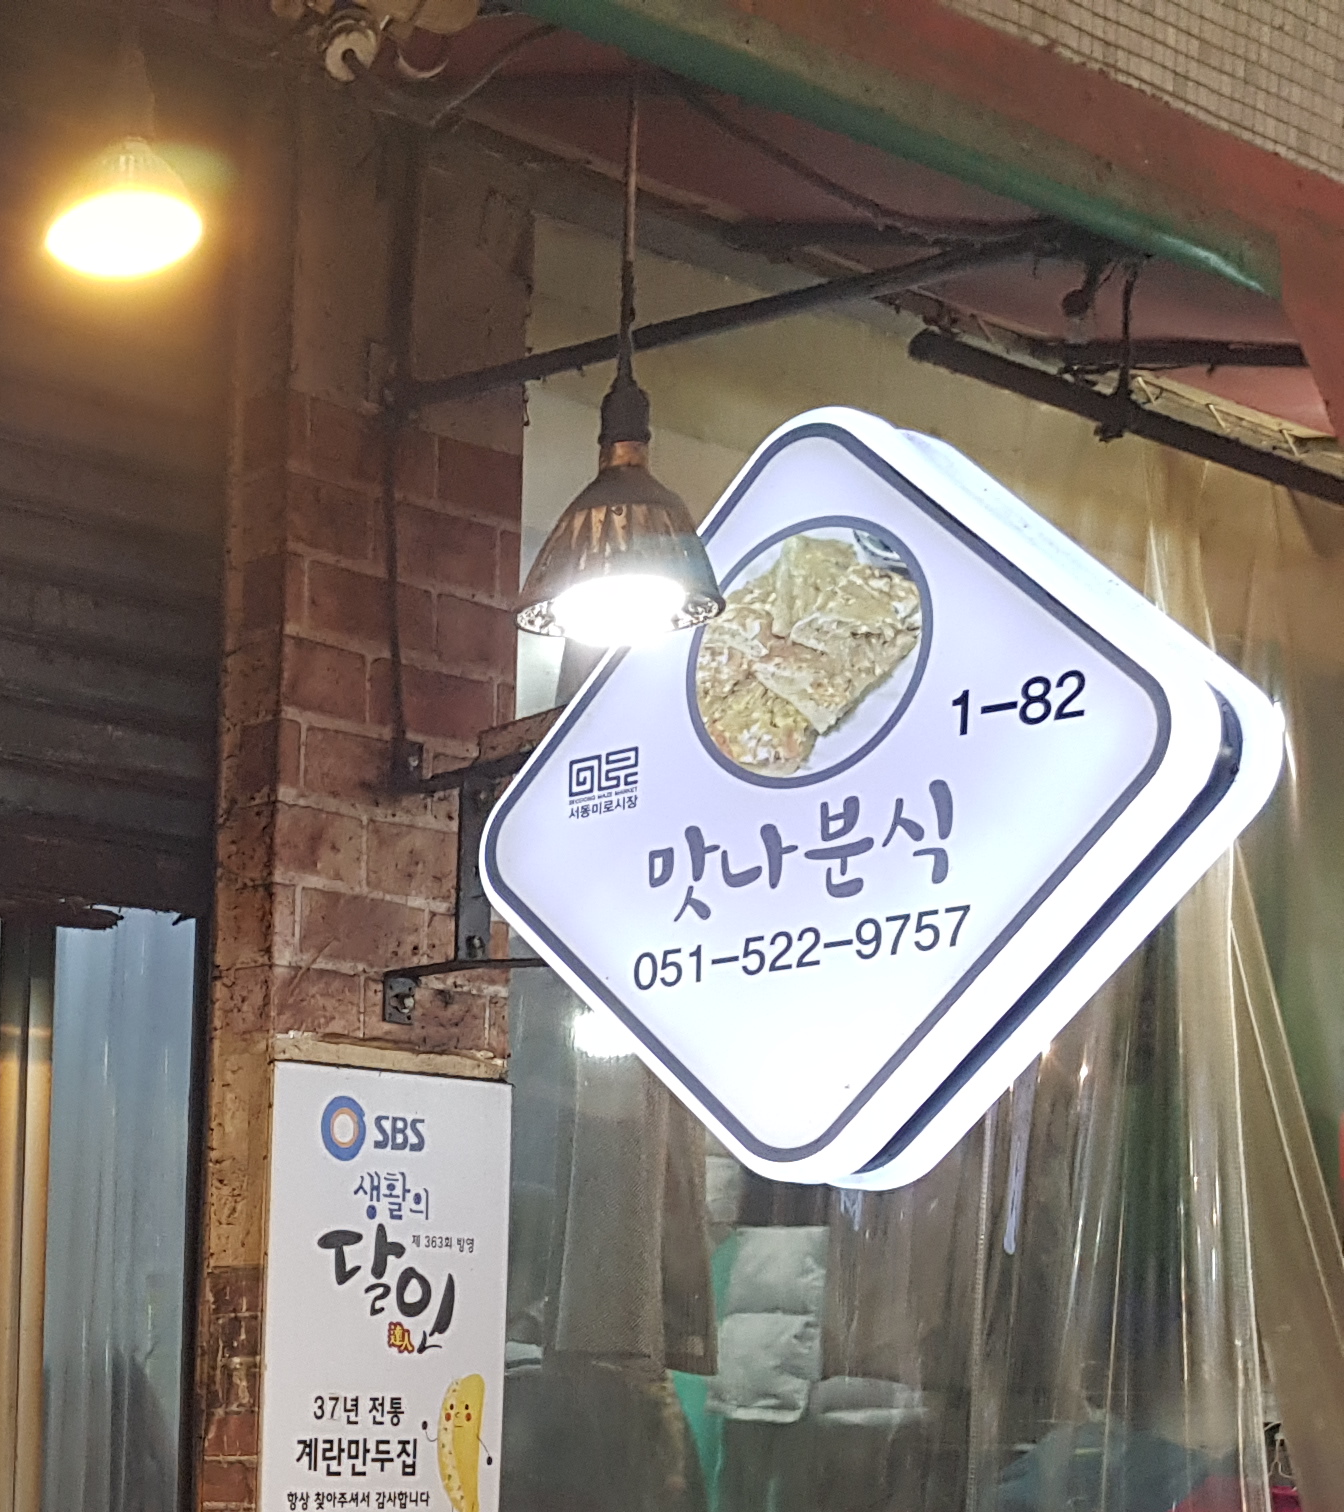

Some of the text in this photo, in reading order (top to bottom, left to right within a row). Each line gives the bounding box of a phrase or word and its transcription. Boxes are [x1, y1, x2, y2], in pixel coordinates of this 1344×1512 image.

[950, 670, 1087, 737] 1-82
[568, 794, 638, 820] 서동미로시장
[632, 904, 973, 992] 051-522-9757
[373, 1114, 426, 1152] SBS
[353, 1171, 429, 1221] 생활의
[317, 1222, 456, 1355] 달인
[313, 1395, 405, 1427] 37년 전통
[295, 1437, 418, 1477] 계란만두집
[286, 1490, 431, 1511] 항상 찾아주셔서 감사합니다
